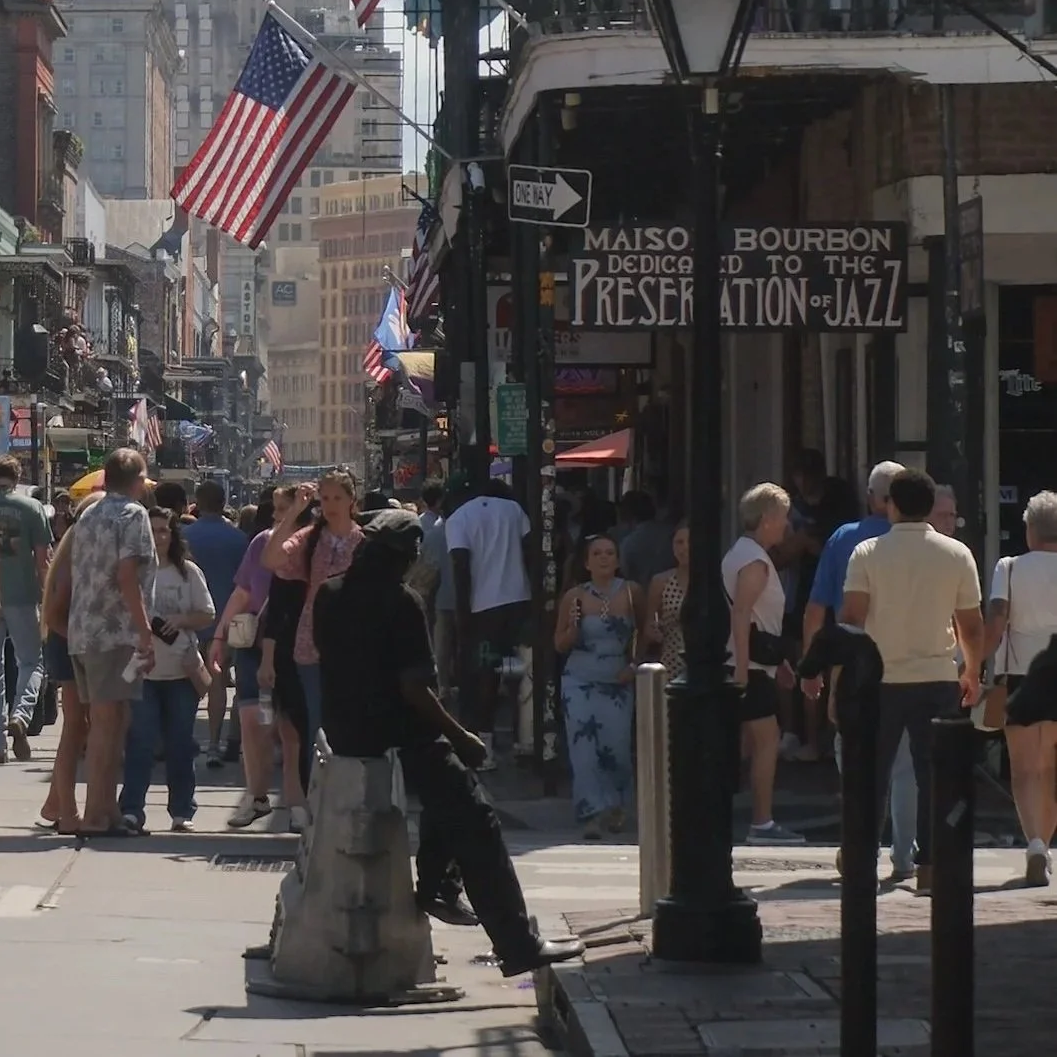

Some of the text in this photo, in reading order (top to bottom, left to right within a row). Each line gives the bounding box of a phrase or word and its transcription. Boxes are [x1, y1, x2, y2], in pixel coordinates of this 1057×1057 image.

[515, 182, 553, 206] ONE WAY
[583, 226, 891, 251] MAISO BOURBON
[607, 254, 876, 275] DEDICAD TO THE
[276, 284, 294, 295] AC
[571, 259, 903, 327] PRESERATION OF JAZZ
[243, 282, 251, 333] ASTOR
